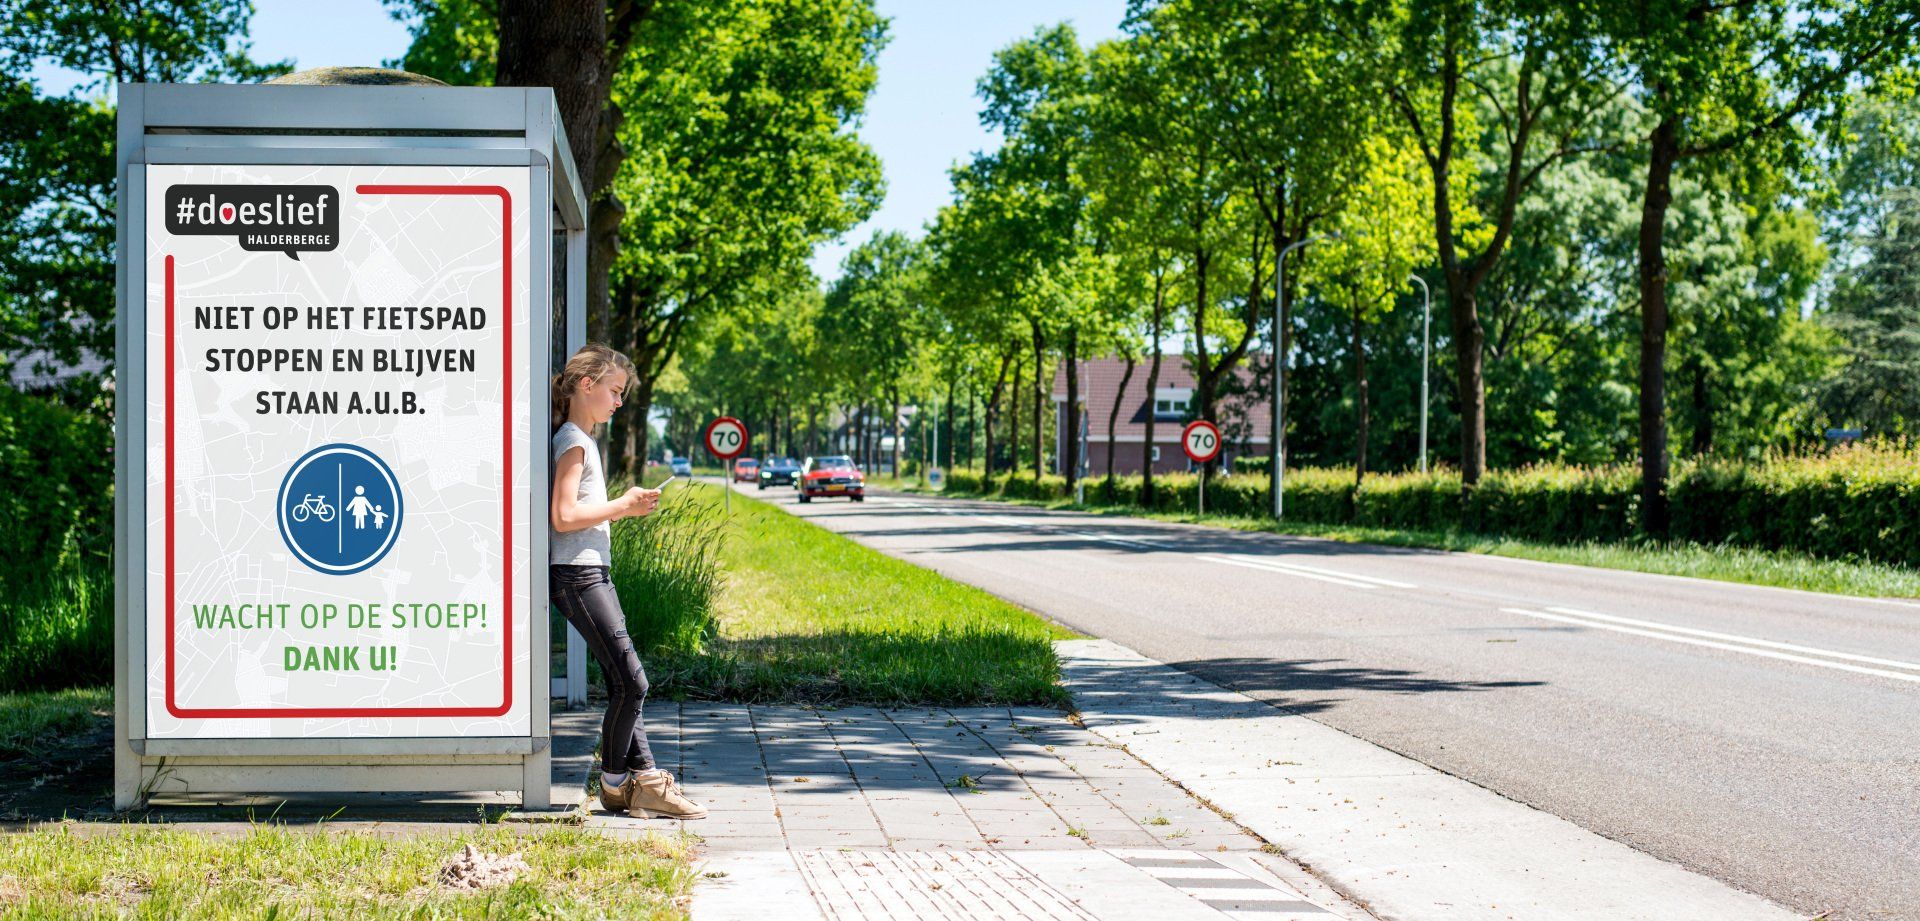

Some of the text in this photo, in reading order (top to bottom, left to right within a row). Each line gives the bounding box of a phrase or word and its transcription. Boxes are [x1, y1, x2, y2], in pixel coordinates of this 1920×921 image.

[247, 234, 331, 245] HALDERBERGE
[195, 306, 487, 331] NIET OP HET FIETSPAD
[205, 348, 475, 377] STOPPEN EN BLIJVEN
[256, 391, 426, 415] STAAN A.U.B.
[713, 431, 740, 447] 70
[1191, 434, 1215, 449] 70
[193, 603, 487, 629] WACHT OP DE STOEP!
[283, 646, 397, 671] DANK U!
